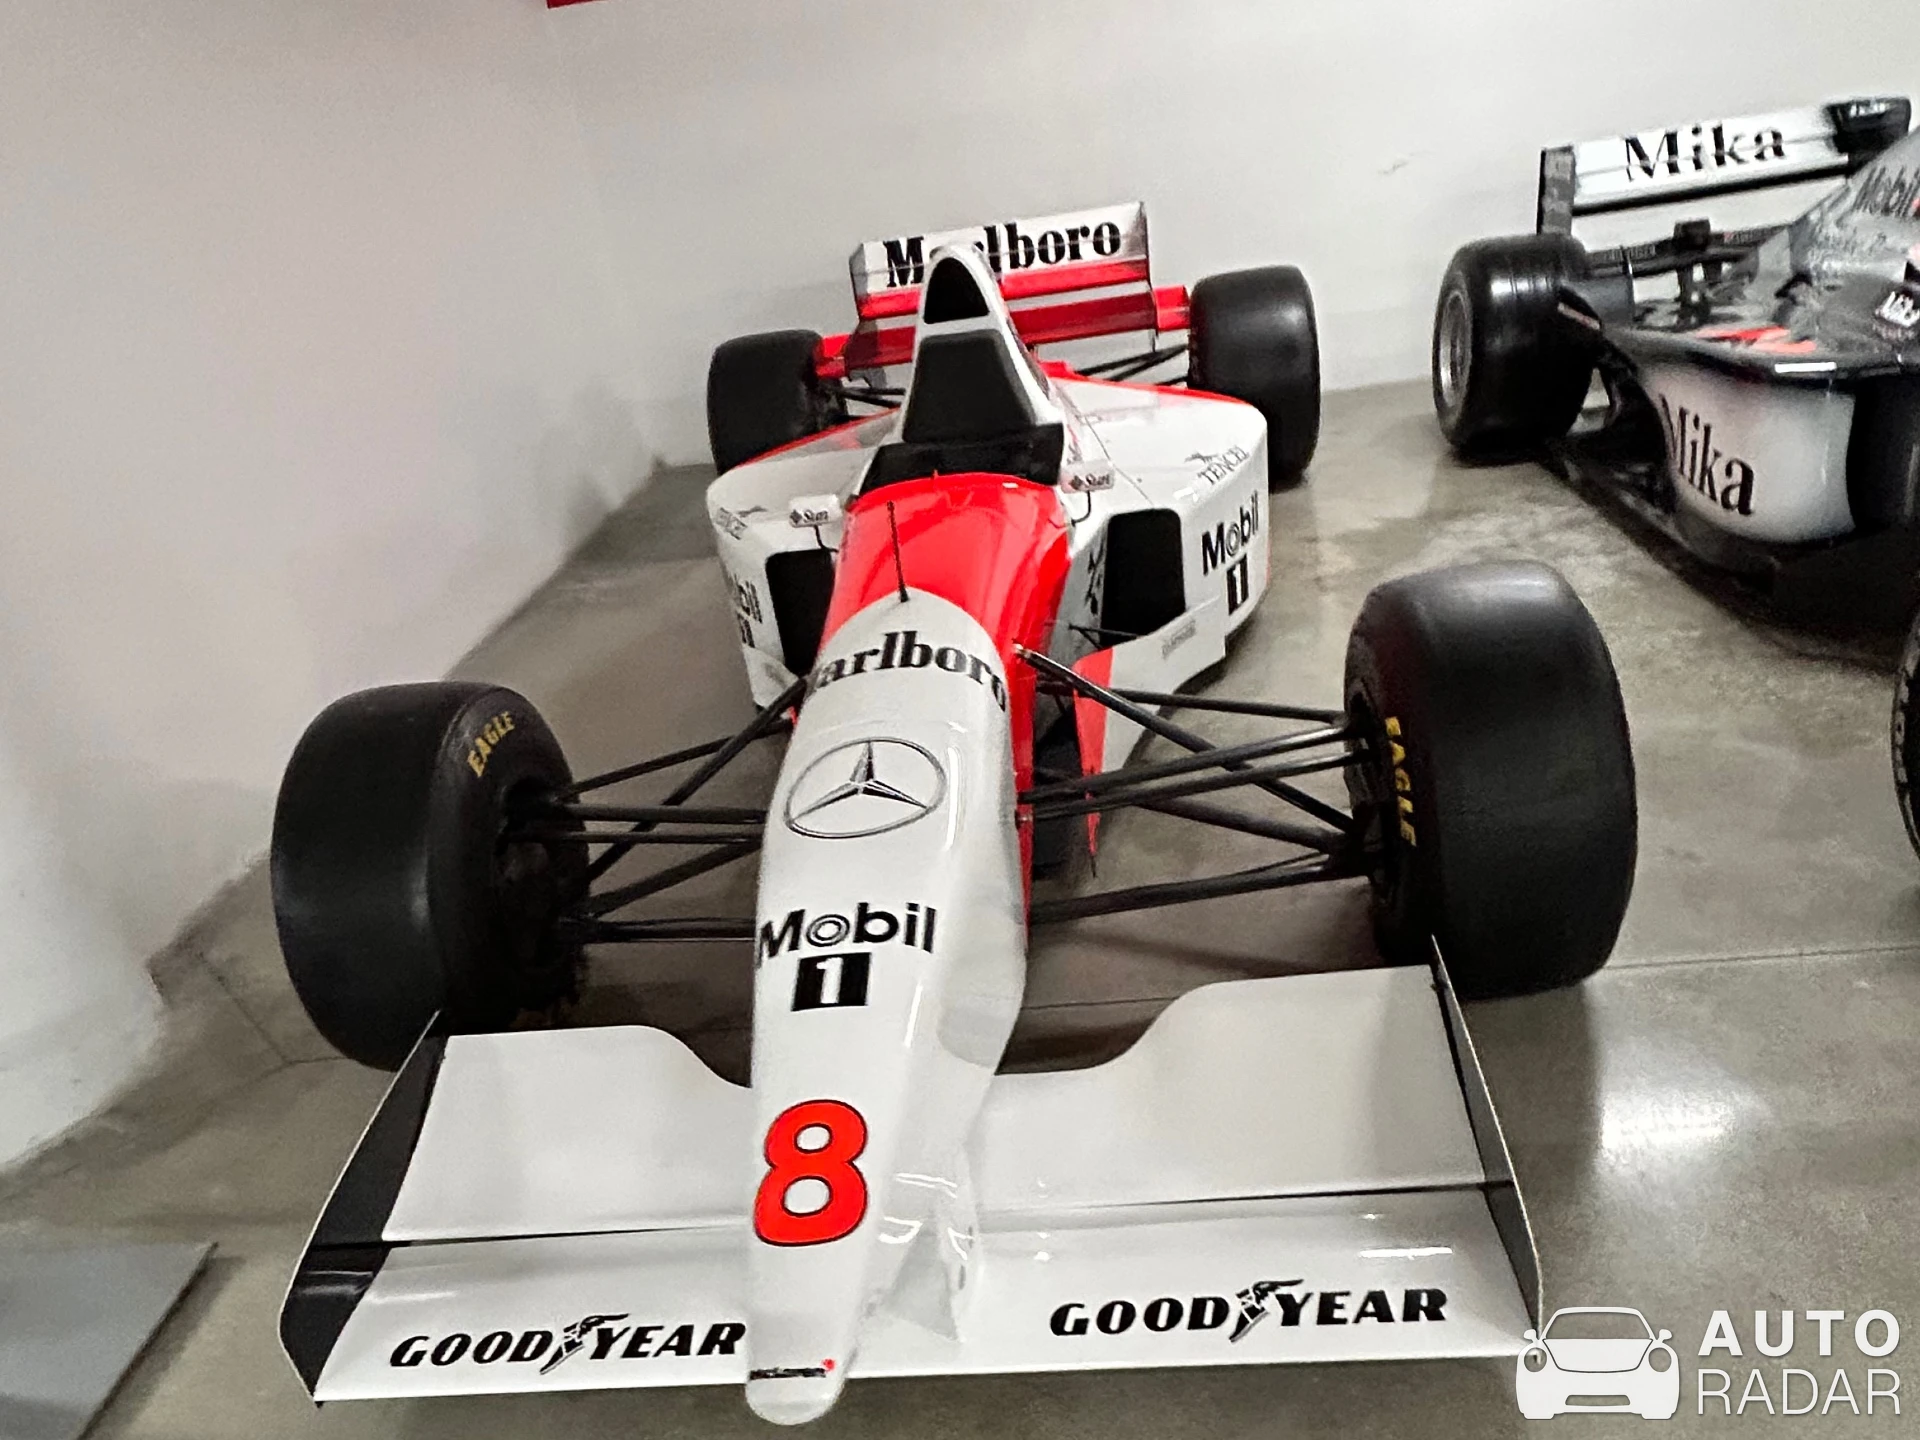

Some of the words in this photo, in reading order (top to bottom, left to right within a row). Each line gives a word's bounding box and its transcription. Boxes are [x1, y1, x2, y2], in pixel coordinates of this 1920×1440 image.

[1624, 122, 1785, 182] Mika
[883, 221, 1121, 288] Mlboro
[1201, 489, 1259, 576] Mobil
[803, 630, 1006, 711] arlboro
[467, 711, 516, 778] EAGLE
[756, 902, 936, 970] Mobil
[754, 1099, 869, 1247] 8
